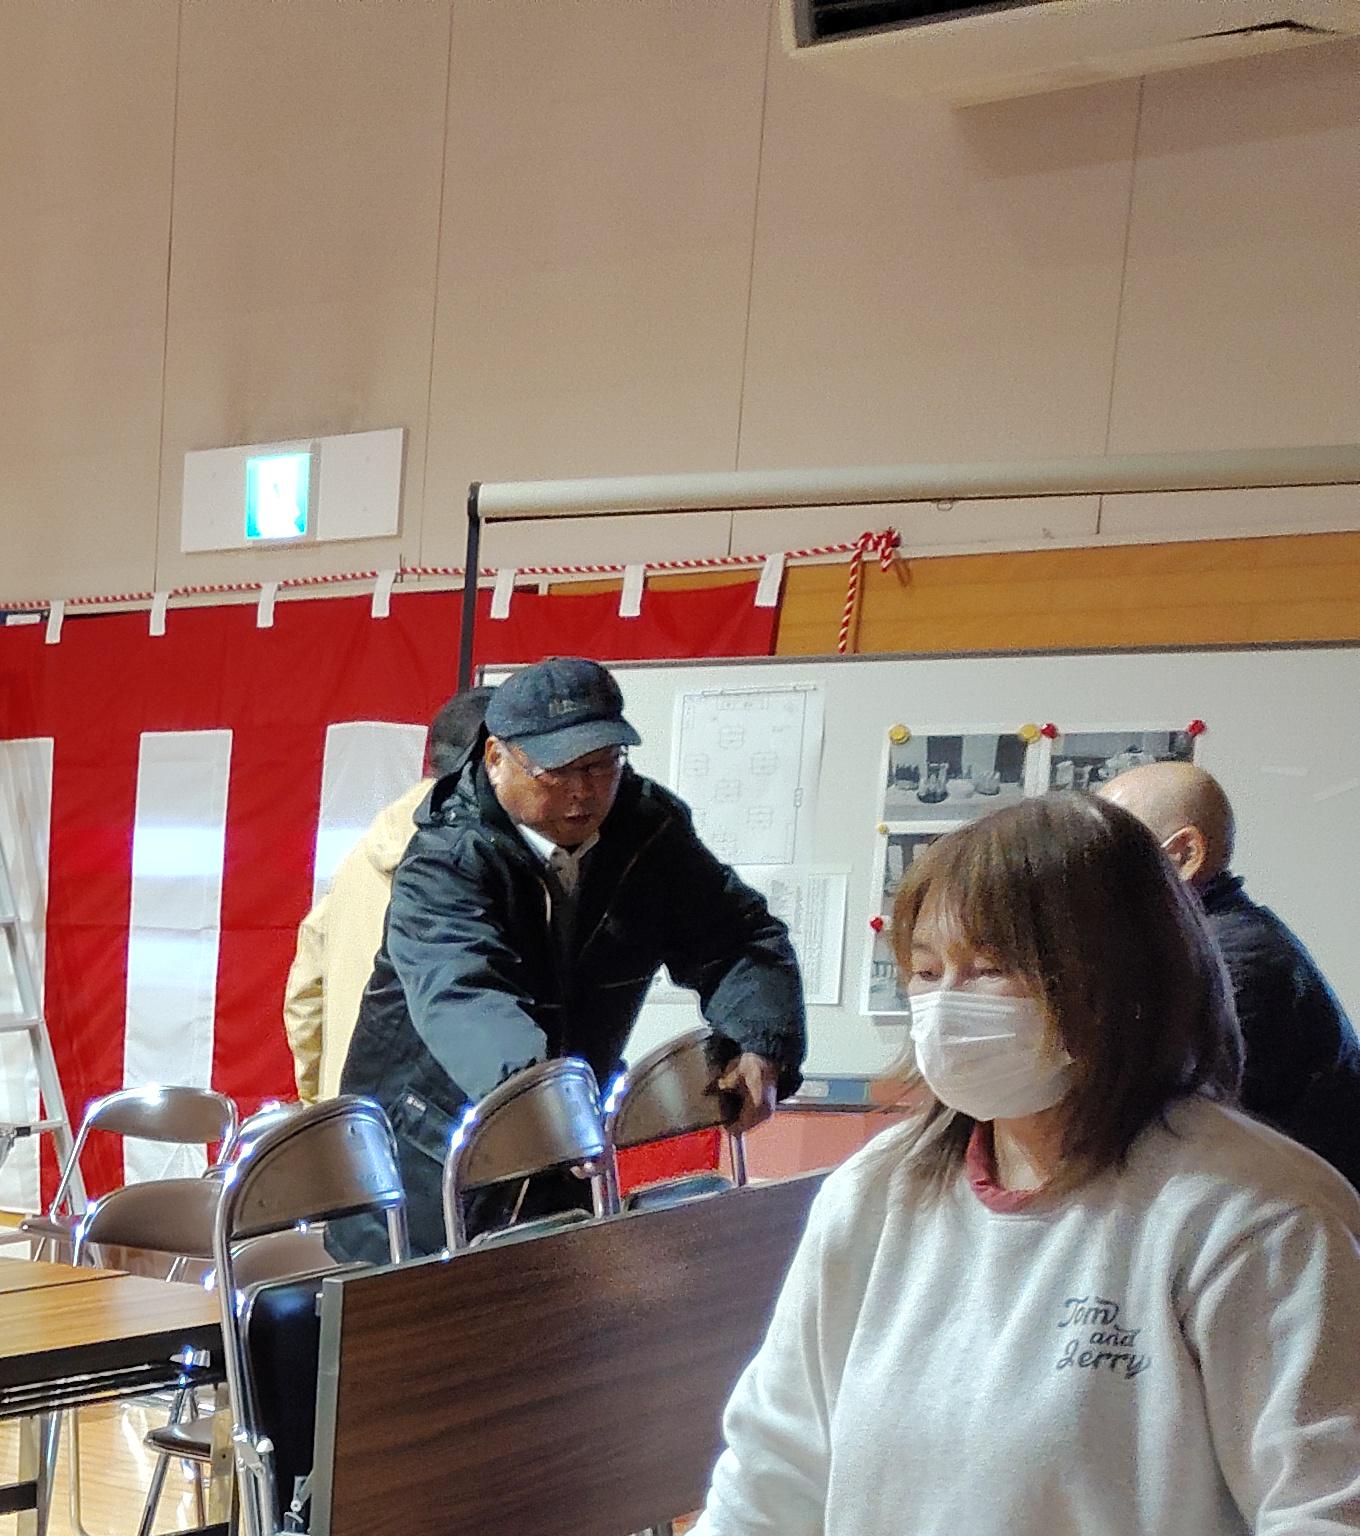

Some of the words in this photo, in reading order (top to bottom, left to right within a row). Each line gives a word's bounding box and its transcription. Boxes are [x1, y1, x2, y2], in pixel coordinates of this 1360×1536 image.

[1057, 1295, 1120, 1328] Tom
[1089, 1325, 1141, 1348] and
[1056, 1339, 1152, 1380] Jerry
